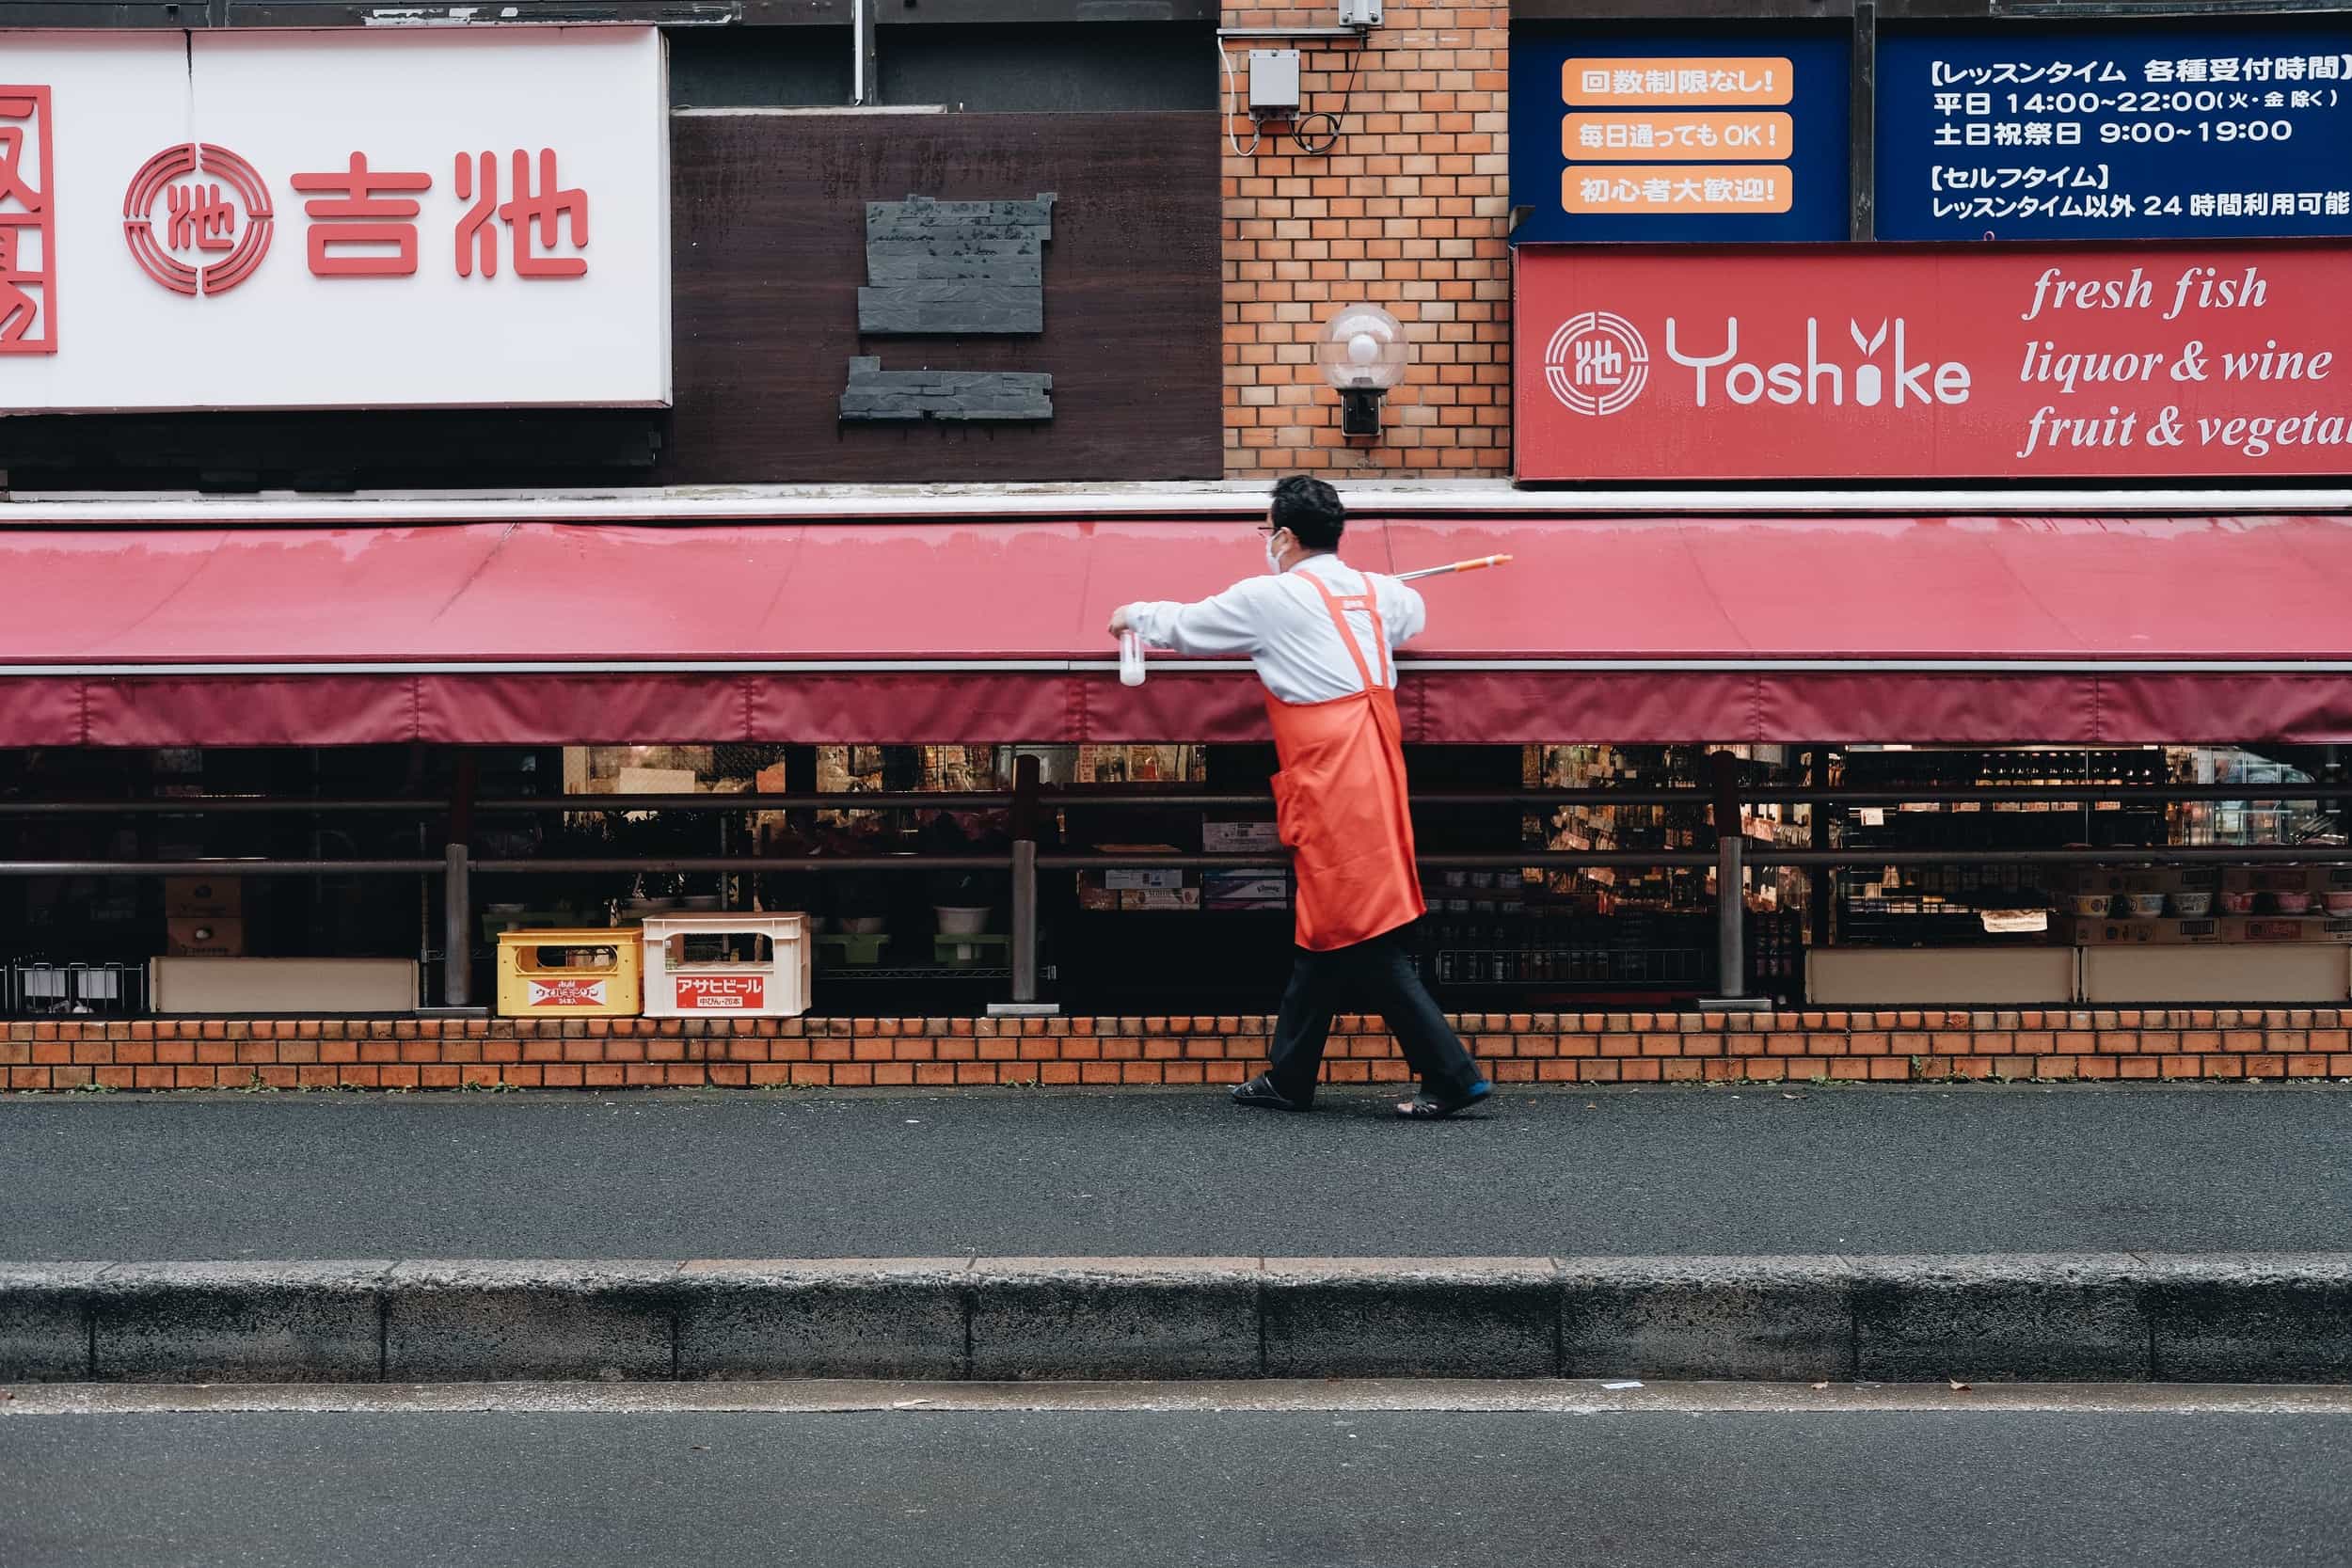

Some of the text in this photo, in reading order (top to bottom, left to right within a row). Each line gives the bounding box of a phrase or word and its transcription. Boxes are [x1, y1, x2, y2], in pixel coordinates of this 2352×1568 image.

[1581, 69, 1774, 95] 回数制限なし!
[1933, 92, 1991, 117] 平日
[1933, 121, 2082, 146] 土日祝祭日
[1580, 177, 1776, 204] 初心者大歓迎!
[1931, 164, 2109, 192] 【セルフタイム】
[291, 148, 589, 278] 吉池
[2189, 190, 2351, 217] 時間利用可能
[2021, 266, 2267, 321] fresh fish
[2020, 340, 2333, 393] liquor & wine
[2016, 405, 2352, 459] fruit & vegeta
[677, 979, 762, 993] アサヒビール
